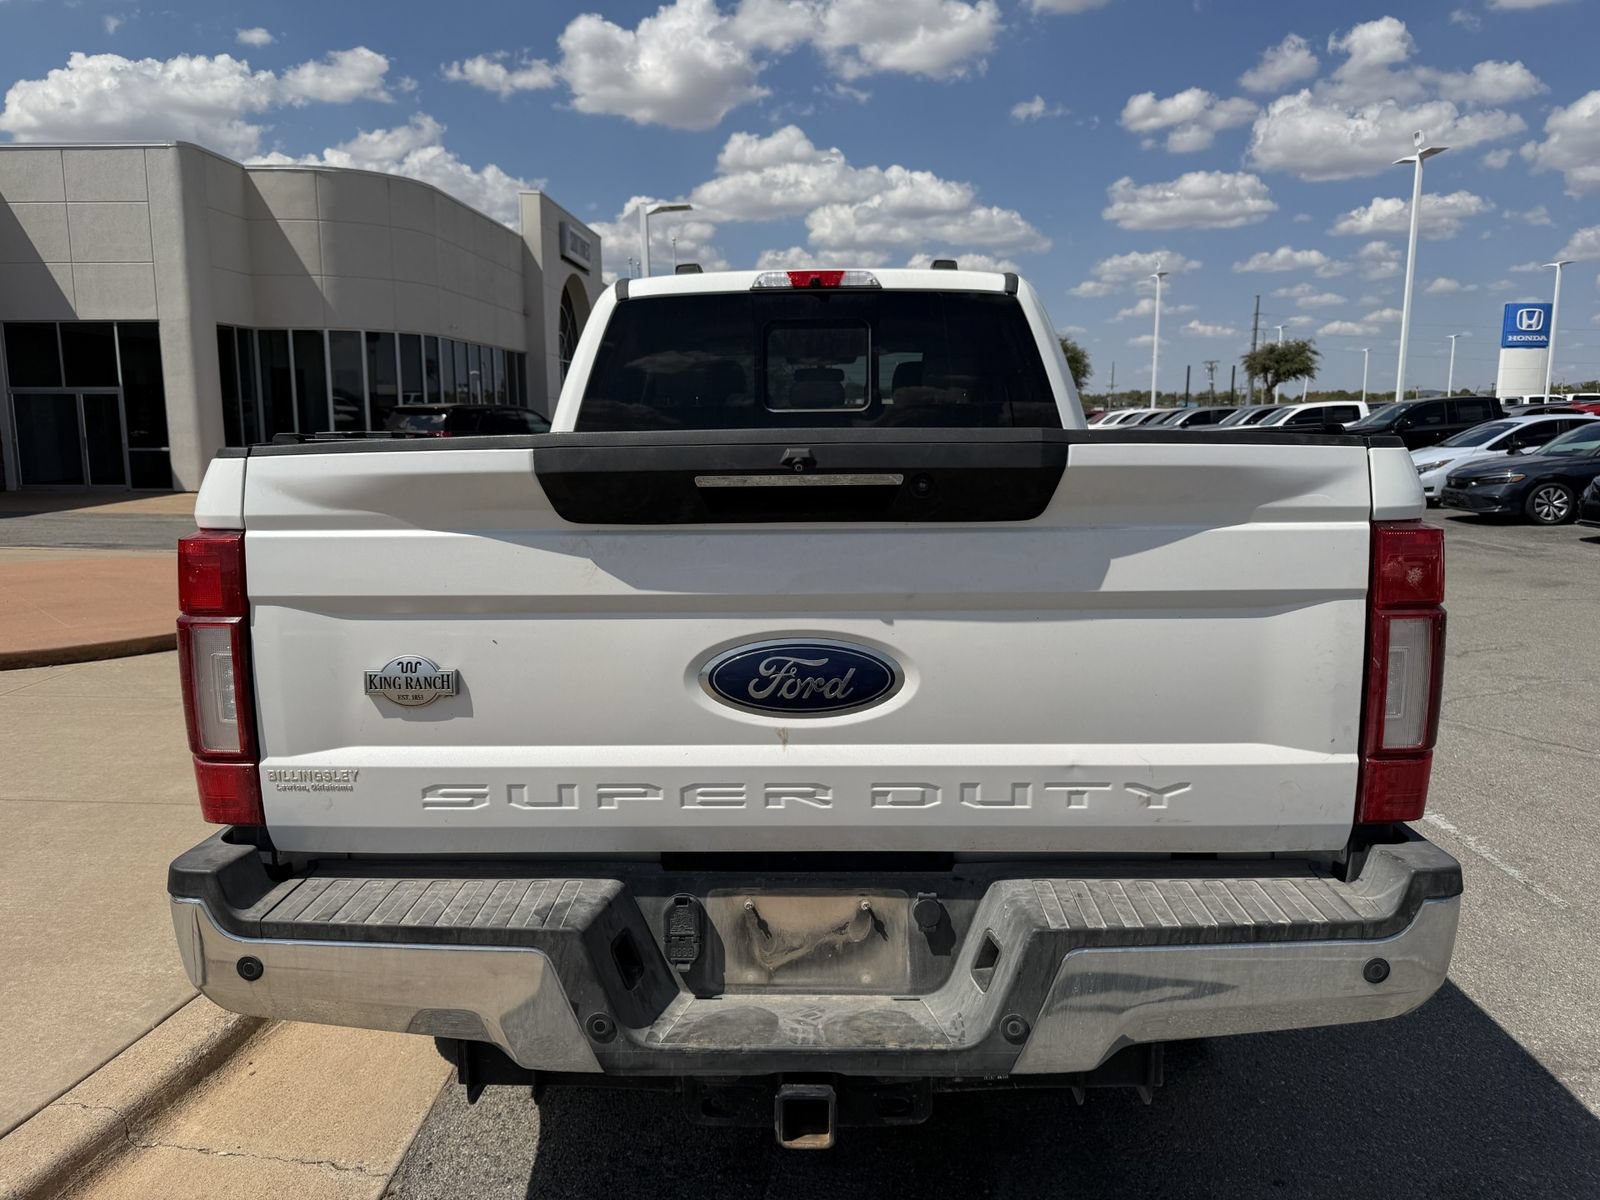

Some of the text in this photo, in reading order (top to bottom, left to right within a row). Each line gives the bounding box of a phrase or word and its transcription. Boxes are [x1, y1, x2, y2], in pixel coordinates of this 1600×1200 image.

[368, 674, 451, 690] KING RANCH
[748, 656, 856, 700] Ford
[267, 769, 359, 782] BILLINGSLEY
[421, 781, 1193, 810] SUPER DUTY
